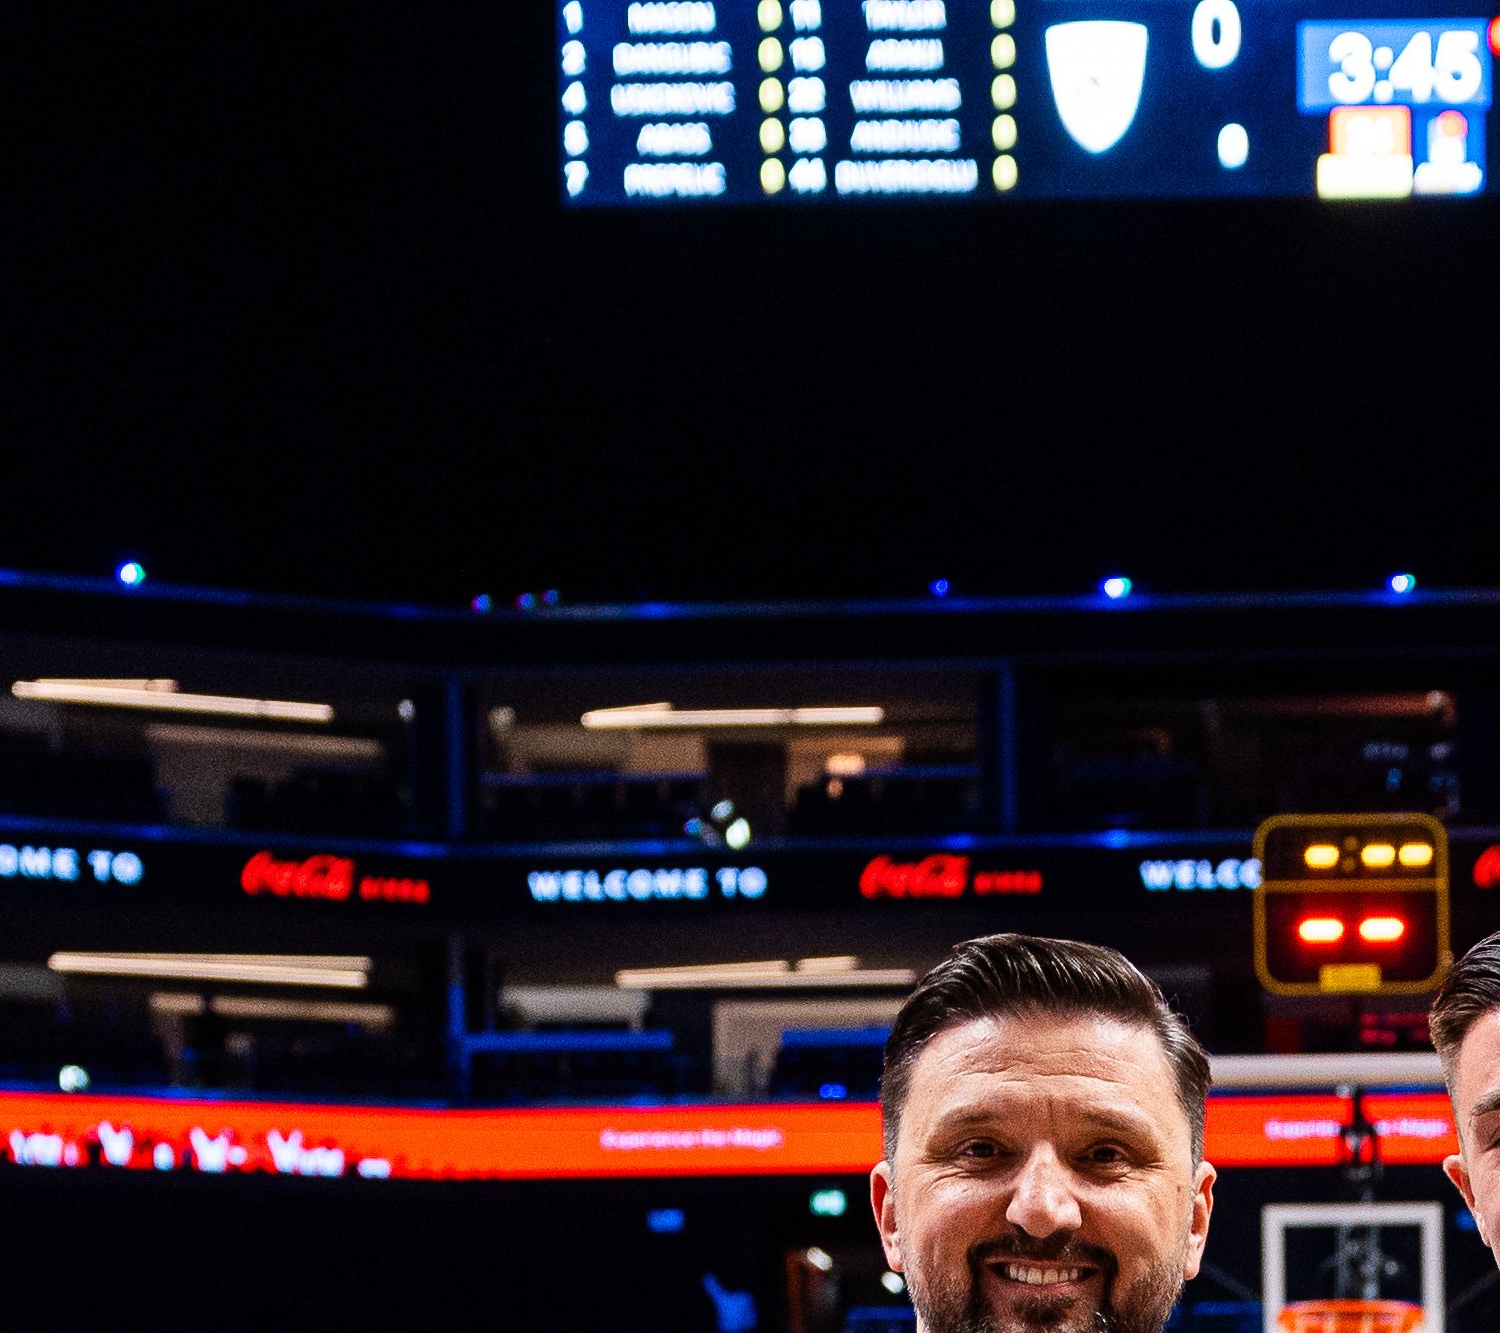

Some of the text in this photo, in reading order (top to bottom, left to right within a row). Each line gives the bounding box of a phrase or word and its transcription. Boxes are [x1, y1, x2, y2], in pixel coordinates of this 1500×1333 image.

[1329, 30, 1483, 104] 3:45
[89, 850, 143, 884] TO
[527, 866, 768, 902] WELCOME TO
